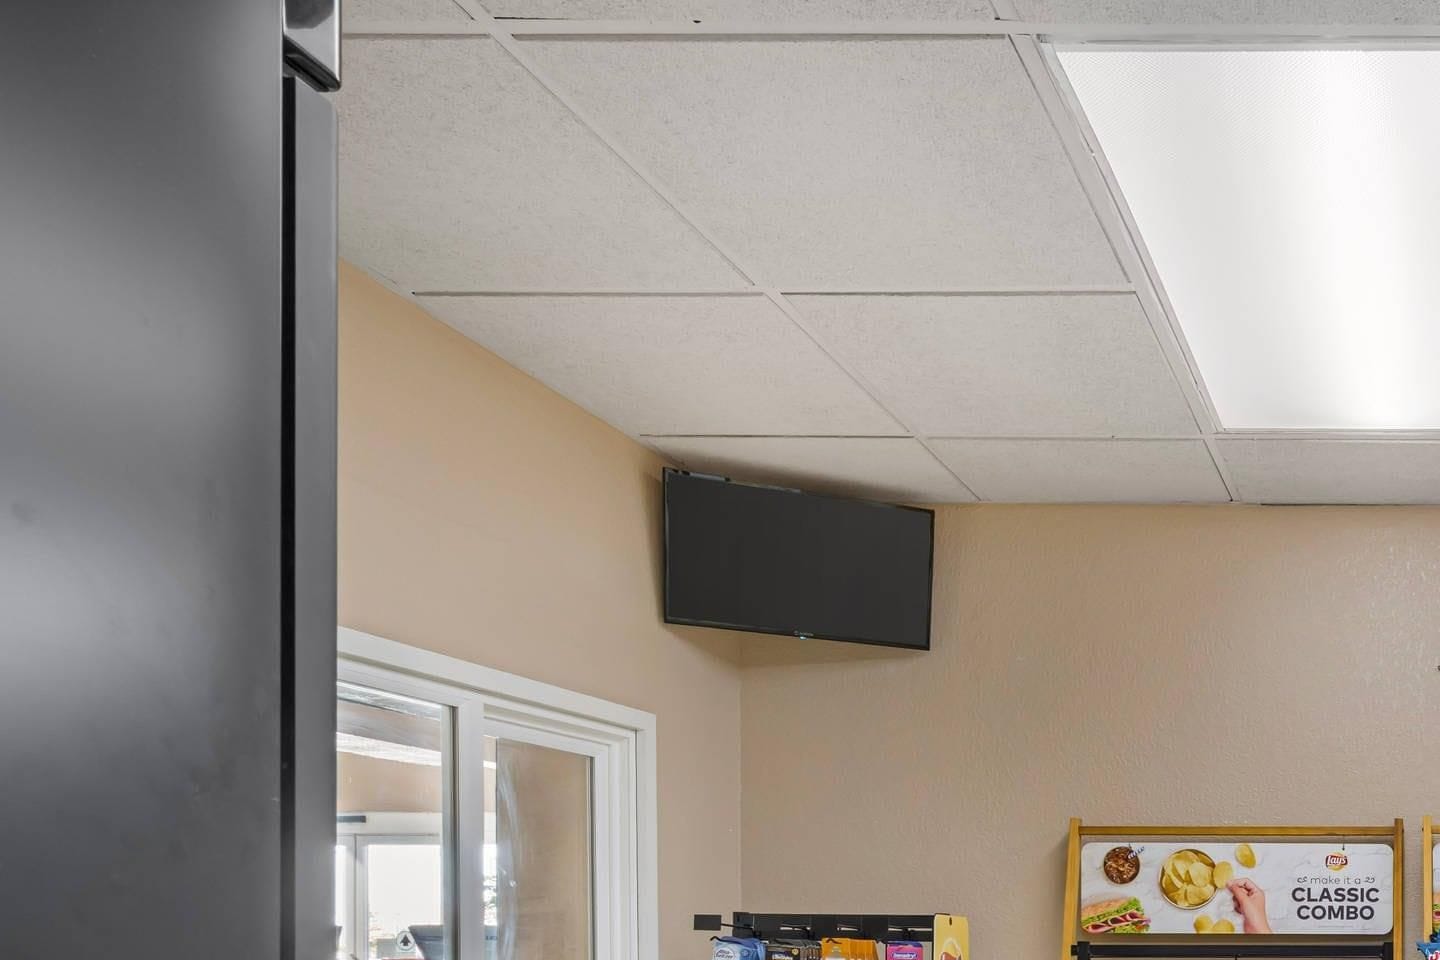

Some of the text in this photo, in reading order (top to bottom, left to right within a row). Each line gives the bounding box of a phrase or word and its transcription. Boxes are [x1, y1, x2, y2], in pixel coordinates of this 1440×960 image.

[1326, 854, 1347, 867] Lay's
[1310, 876, 1341, 885] make
[1343, 876, 1352, 885] it
[1291, 887, 1380, 903] CLASSIC
[1296, 905, 1375, 920] COMBO
